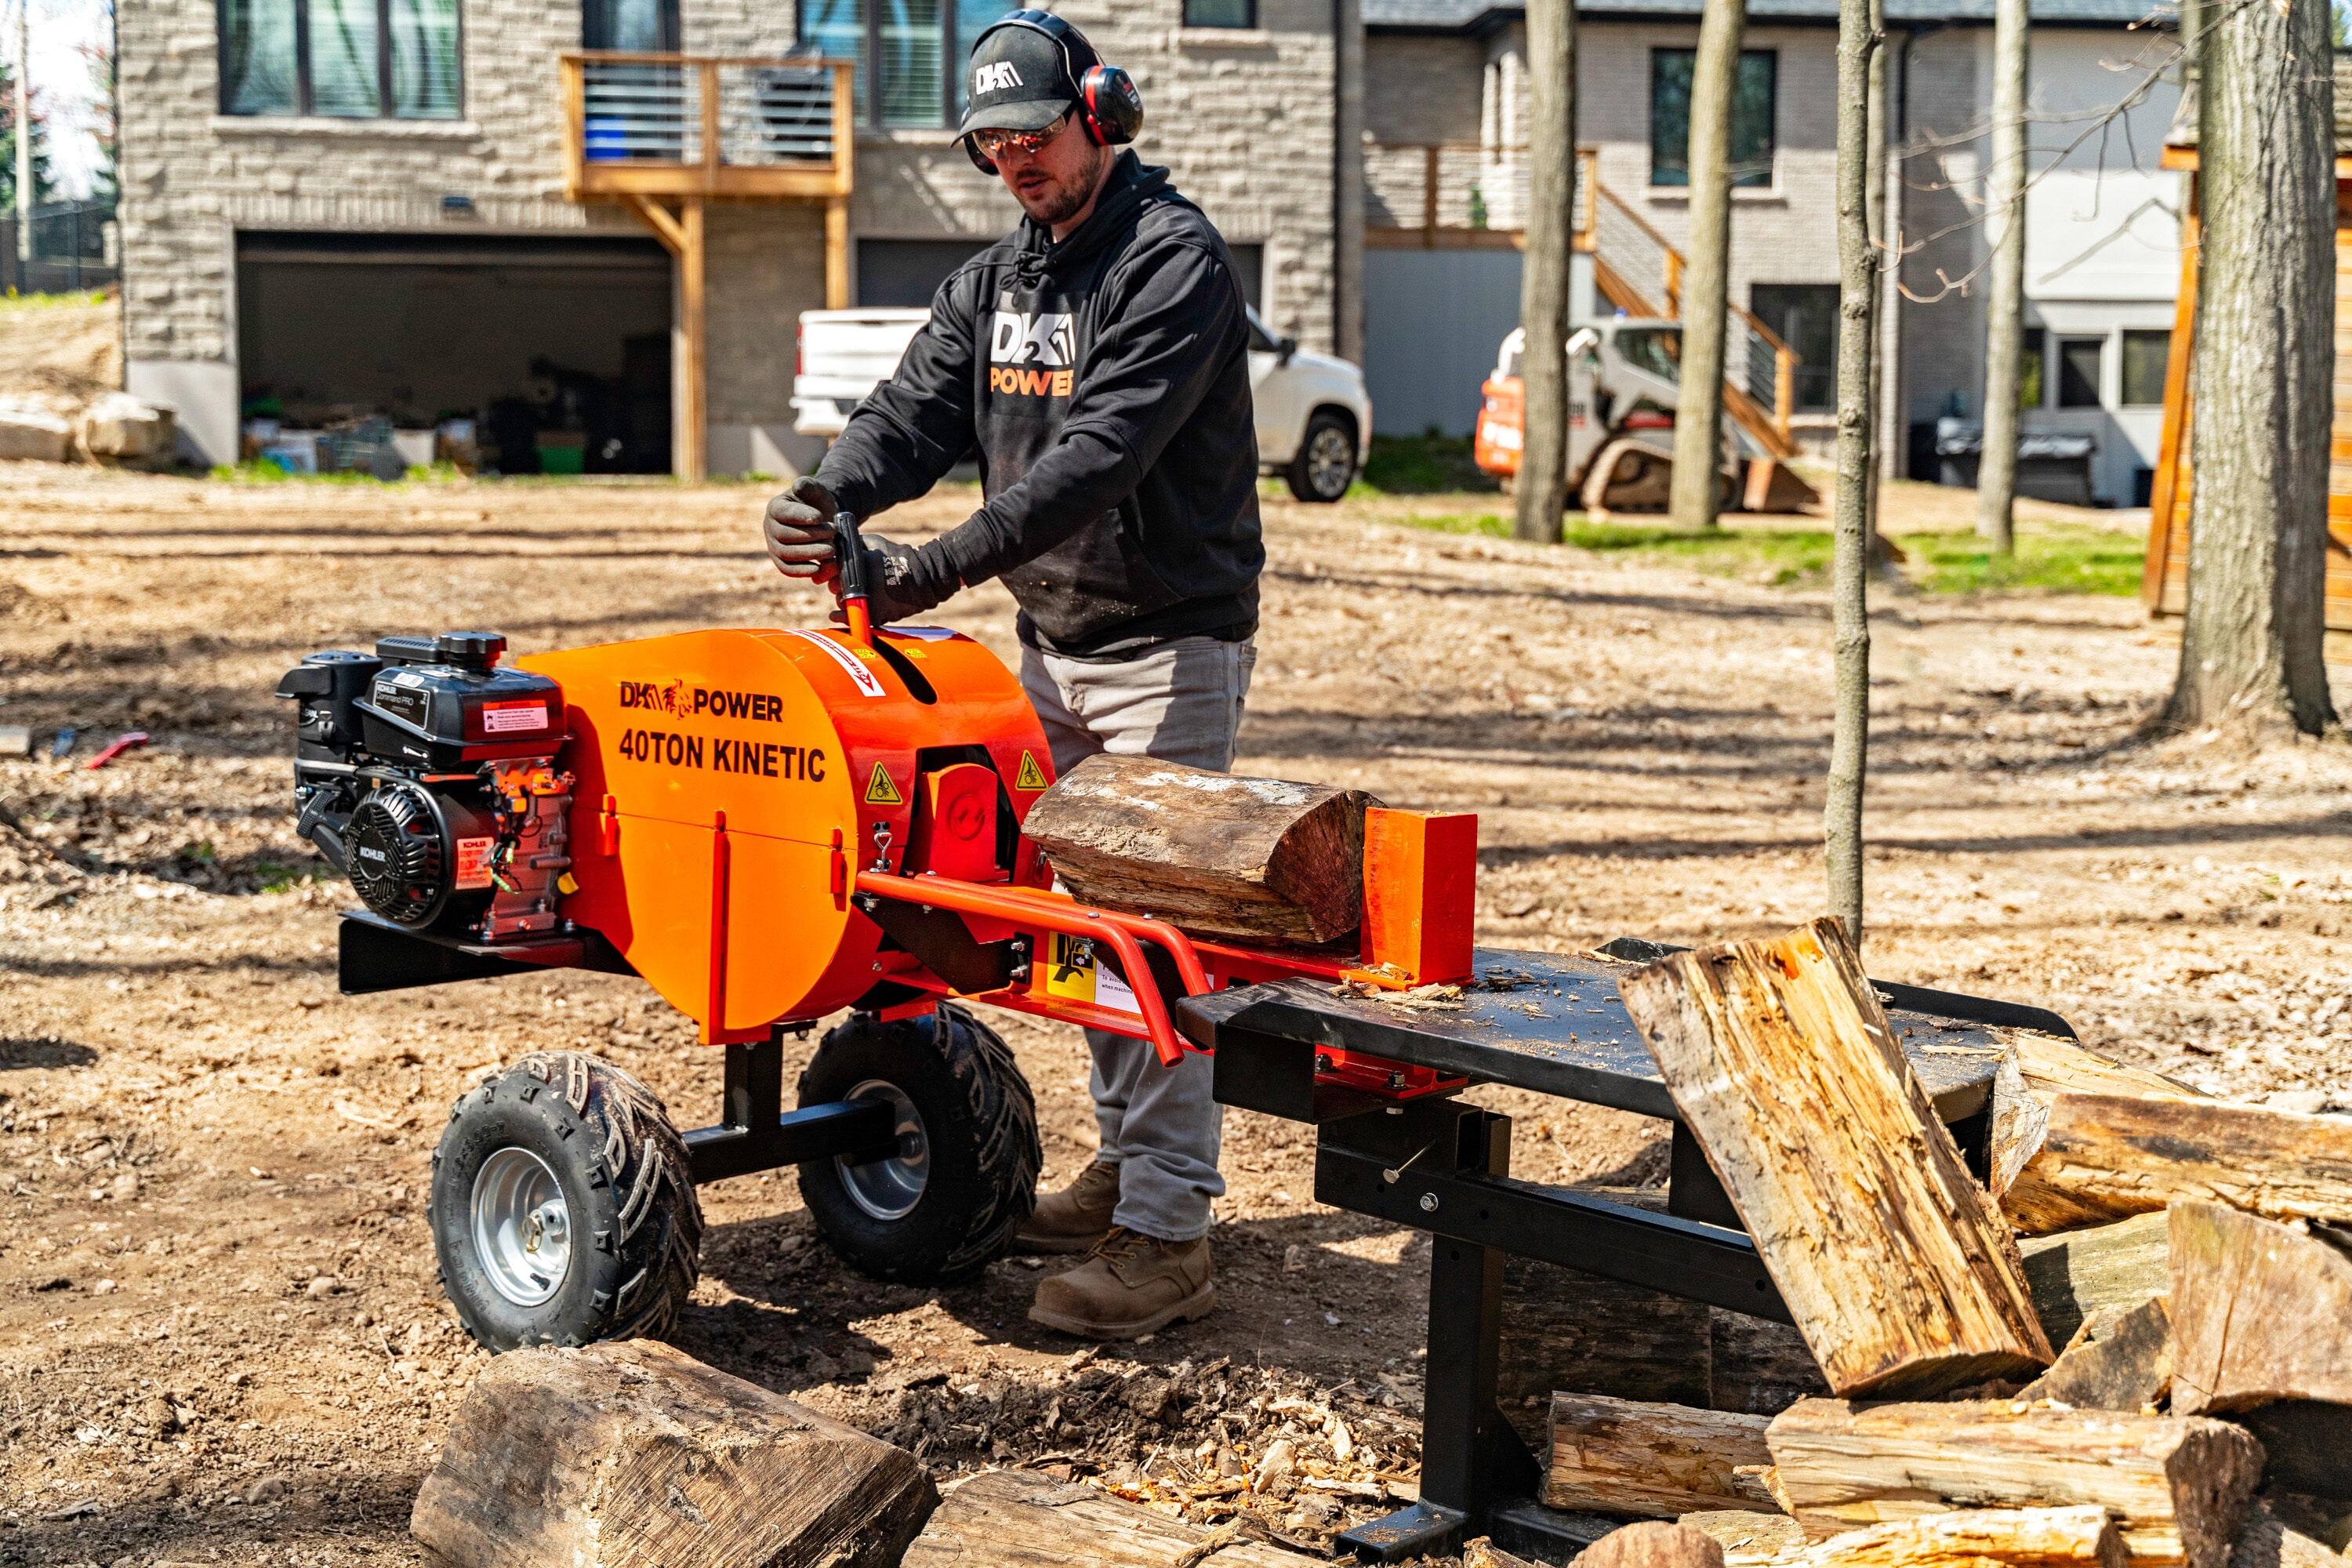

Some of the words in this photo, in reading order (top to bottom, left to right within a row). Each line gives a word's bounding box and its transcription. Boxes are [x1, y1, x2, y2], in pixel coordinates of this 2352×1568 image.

[376, 691, 401, 703] Command
[401, 695, 414, 706] PRO
[694, 688, 783, 722] POWER
[619, 728, 703, 768] 40TON
[713, 739, 826, 782] KINETIC
[360, 846, 386, 862] KOHLER
